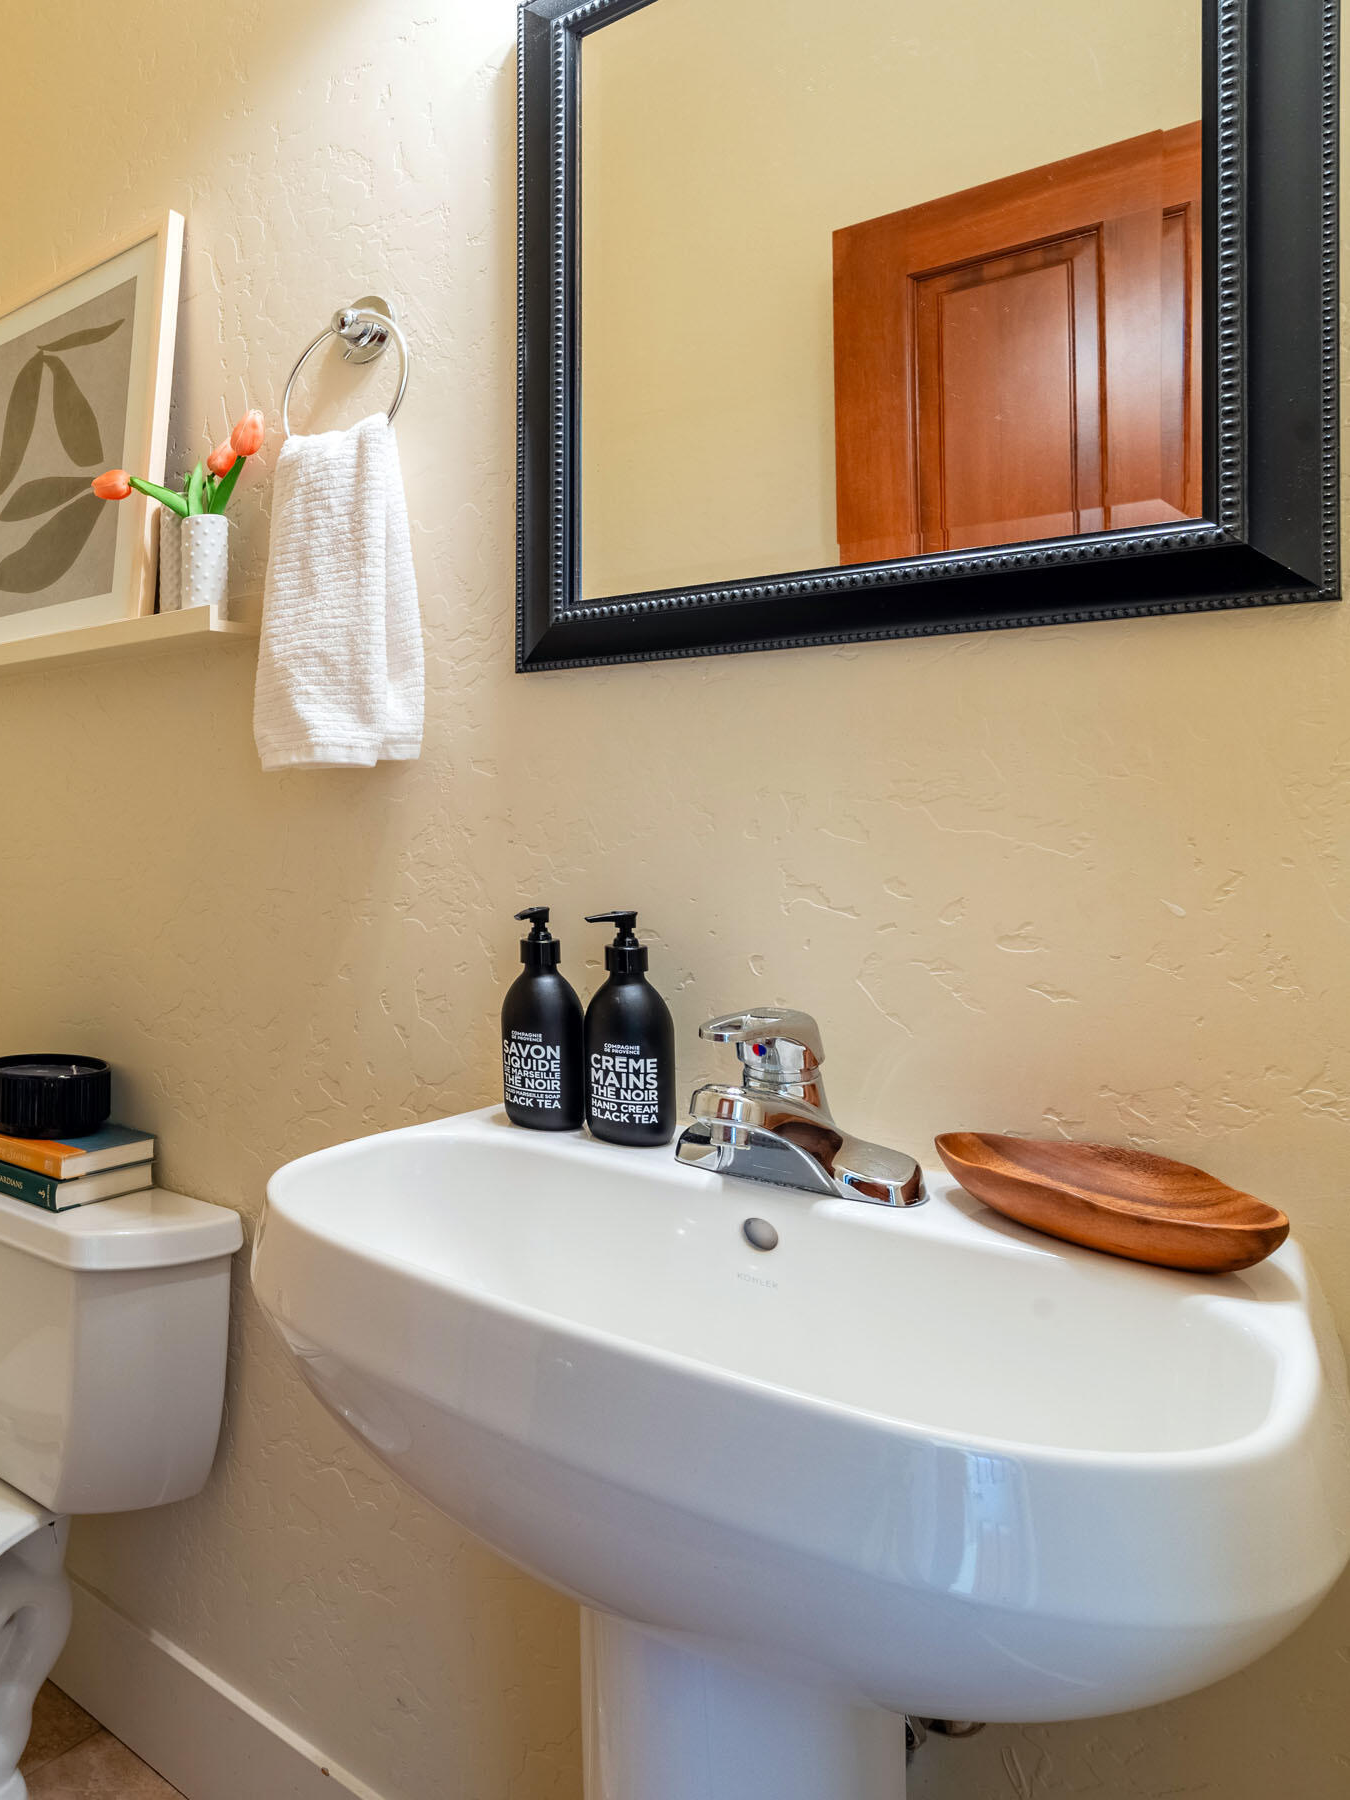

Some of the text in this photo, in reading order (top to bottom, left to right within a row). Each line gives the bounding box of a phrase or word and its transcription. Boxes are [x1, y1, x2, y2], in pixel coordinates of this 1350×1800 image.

[511, 1030, 542, 1038] COMPAGNIE
[503, 1039, 561, 1060] SAVON
[603, 1043, 640, 1051] COMPAGNIE
[503, 1052, 561, 1072] LIQUIDE
[511, 1067, 561, 1080] MARSEILLE
[591, 1067, 658, 1090] MAINS
[525, 1078, 561, 1091] NOIR
[505, 1091, 562, 1109] BLACK TEA
[516, 1089, 544, 1099] MARSEILLE
[620, 1089, 658, 1101] NOIR
[591, 1097, 659, 1114] HAND CREAM
[591, 1106, 659, 1124] BLACK TEA
